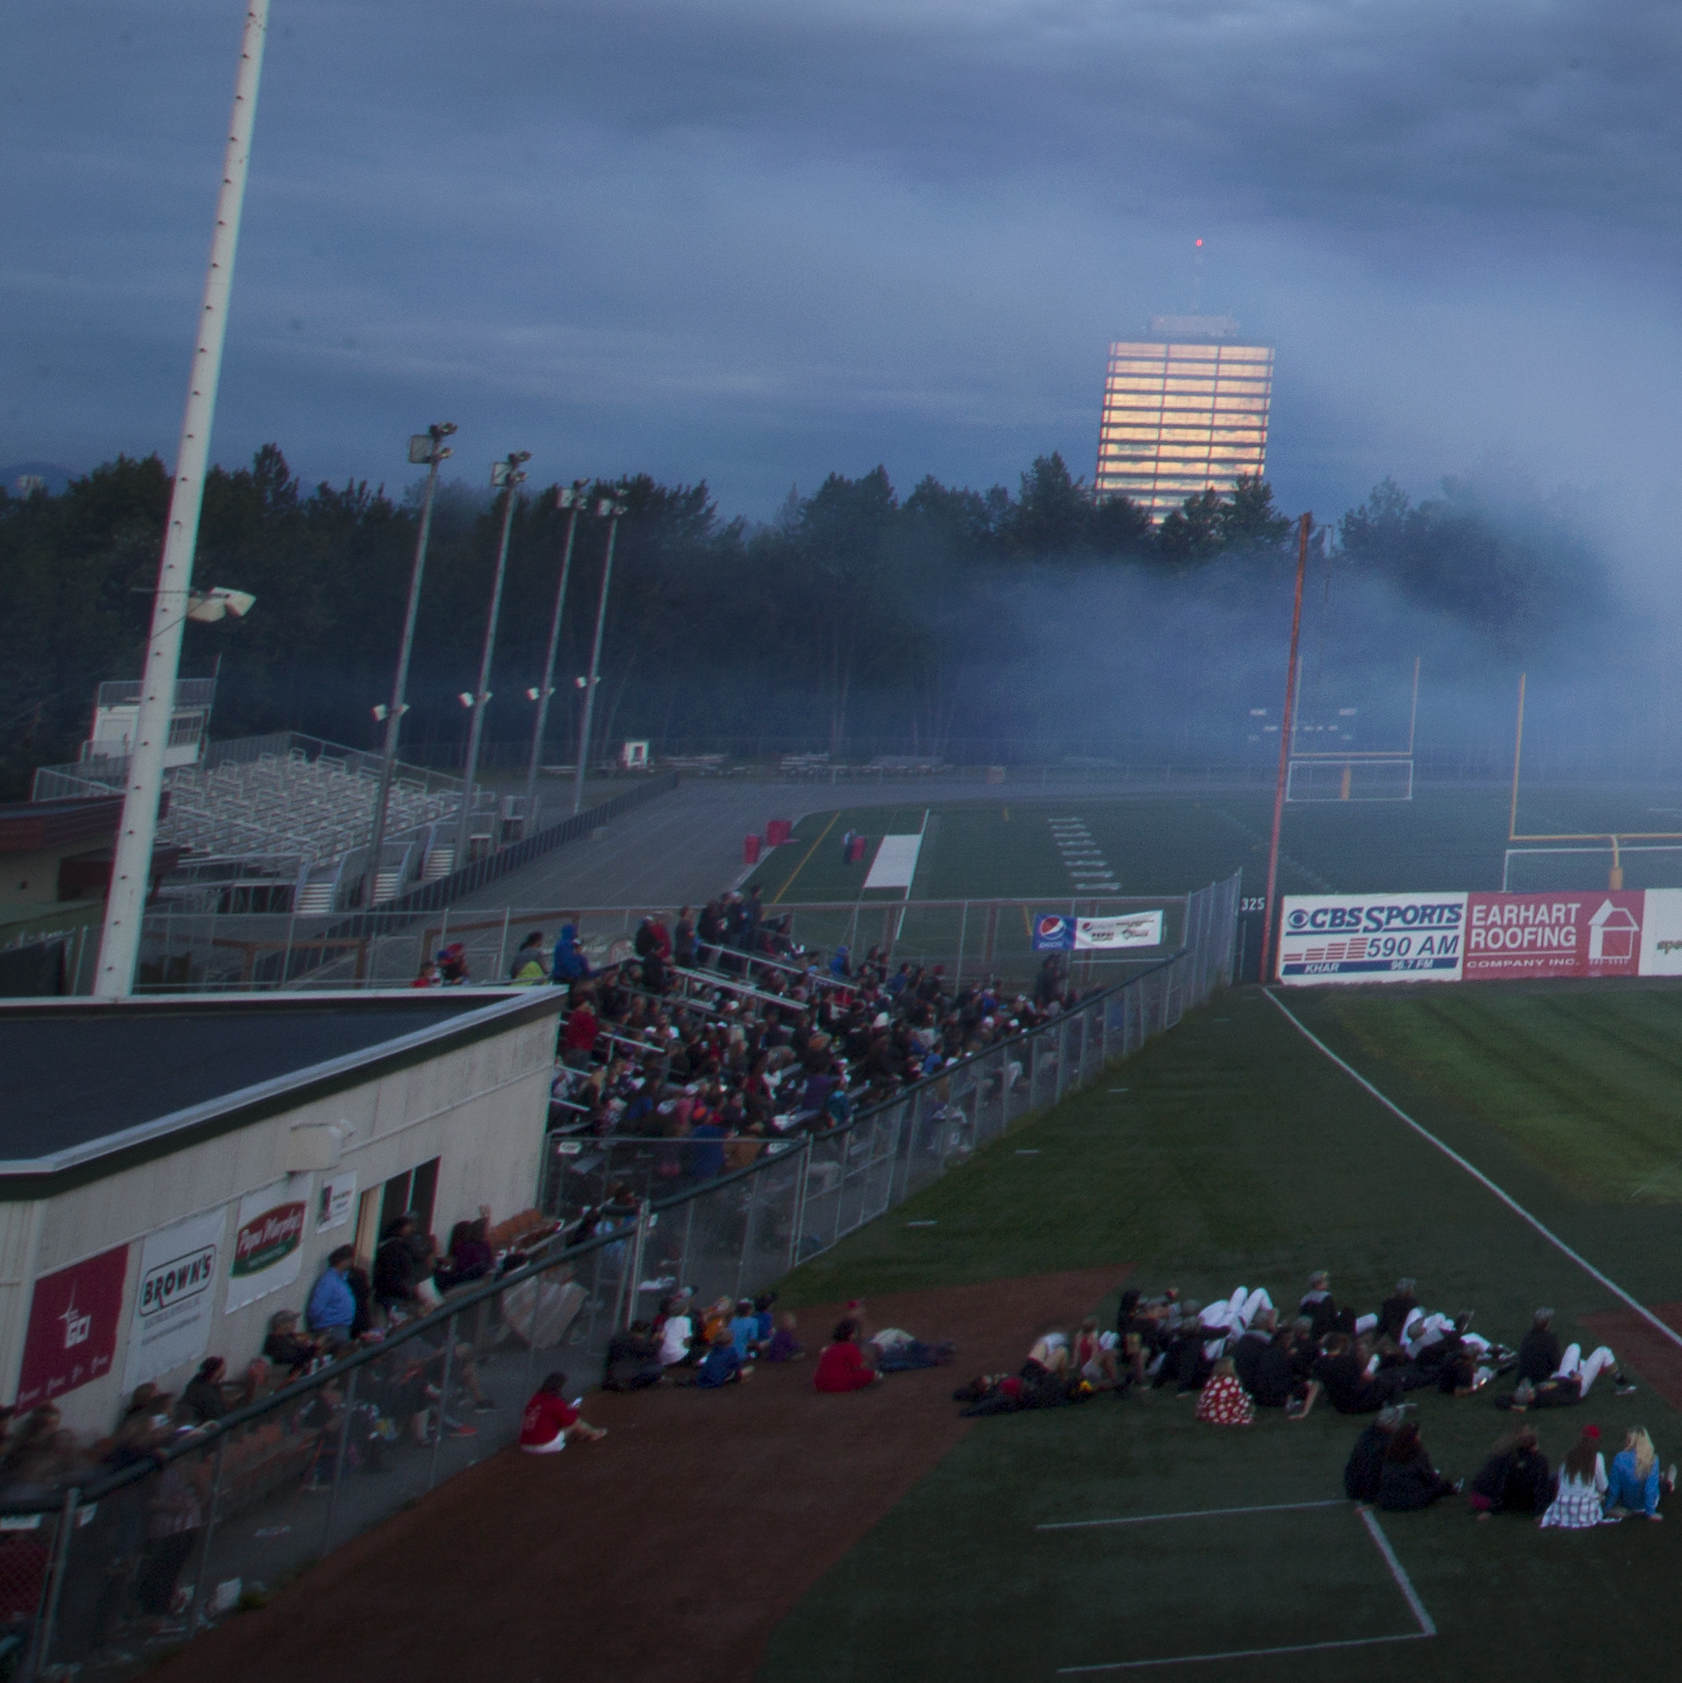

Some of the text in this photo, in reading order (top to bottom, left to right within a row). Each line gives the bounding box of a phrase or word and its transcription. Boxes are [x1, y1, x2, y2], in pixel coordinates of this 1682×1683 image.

[1241, 897, 1265, 912] 325
[1471, 902, 1581, 926] EARHART
[1309, 906, 1364, 929] CBS
[1367, 935, 1460, 959] 590 AM
[1470, 926, 1577, 950] ROOFING
[1304, 962, 1340, 974] KHAR
[1416, 959, 1434, 970] FM
[1466, 959, 1545, 969] COMPANY
[1549, 958, 1579, 967] INC.
[143, 1253, 213, 1308] BROWN'S
